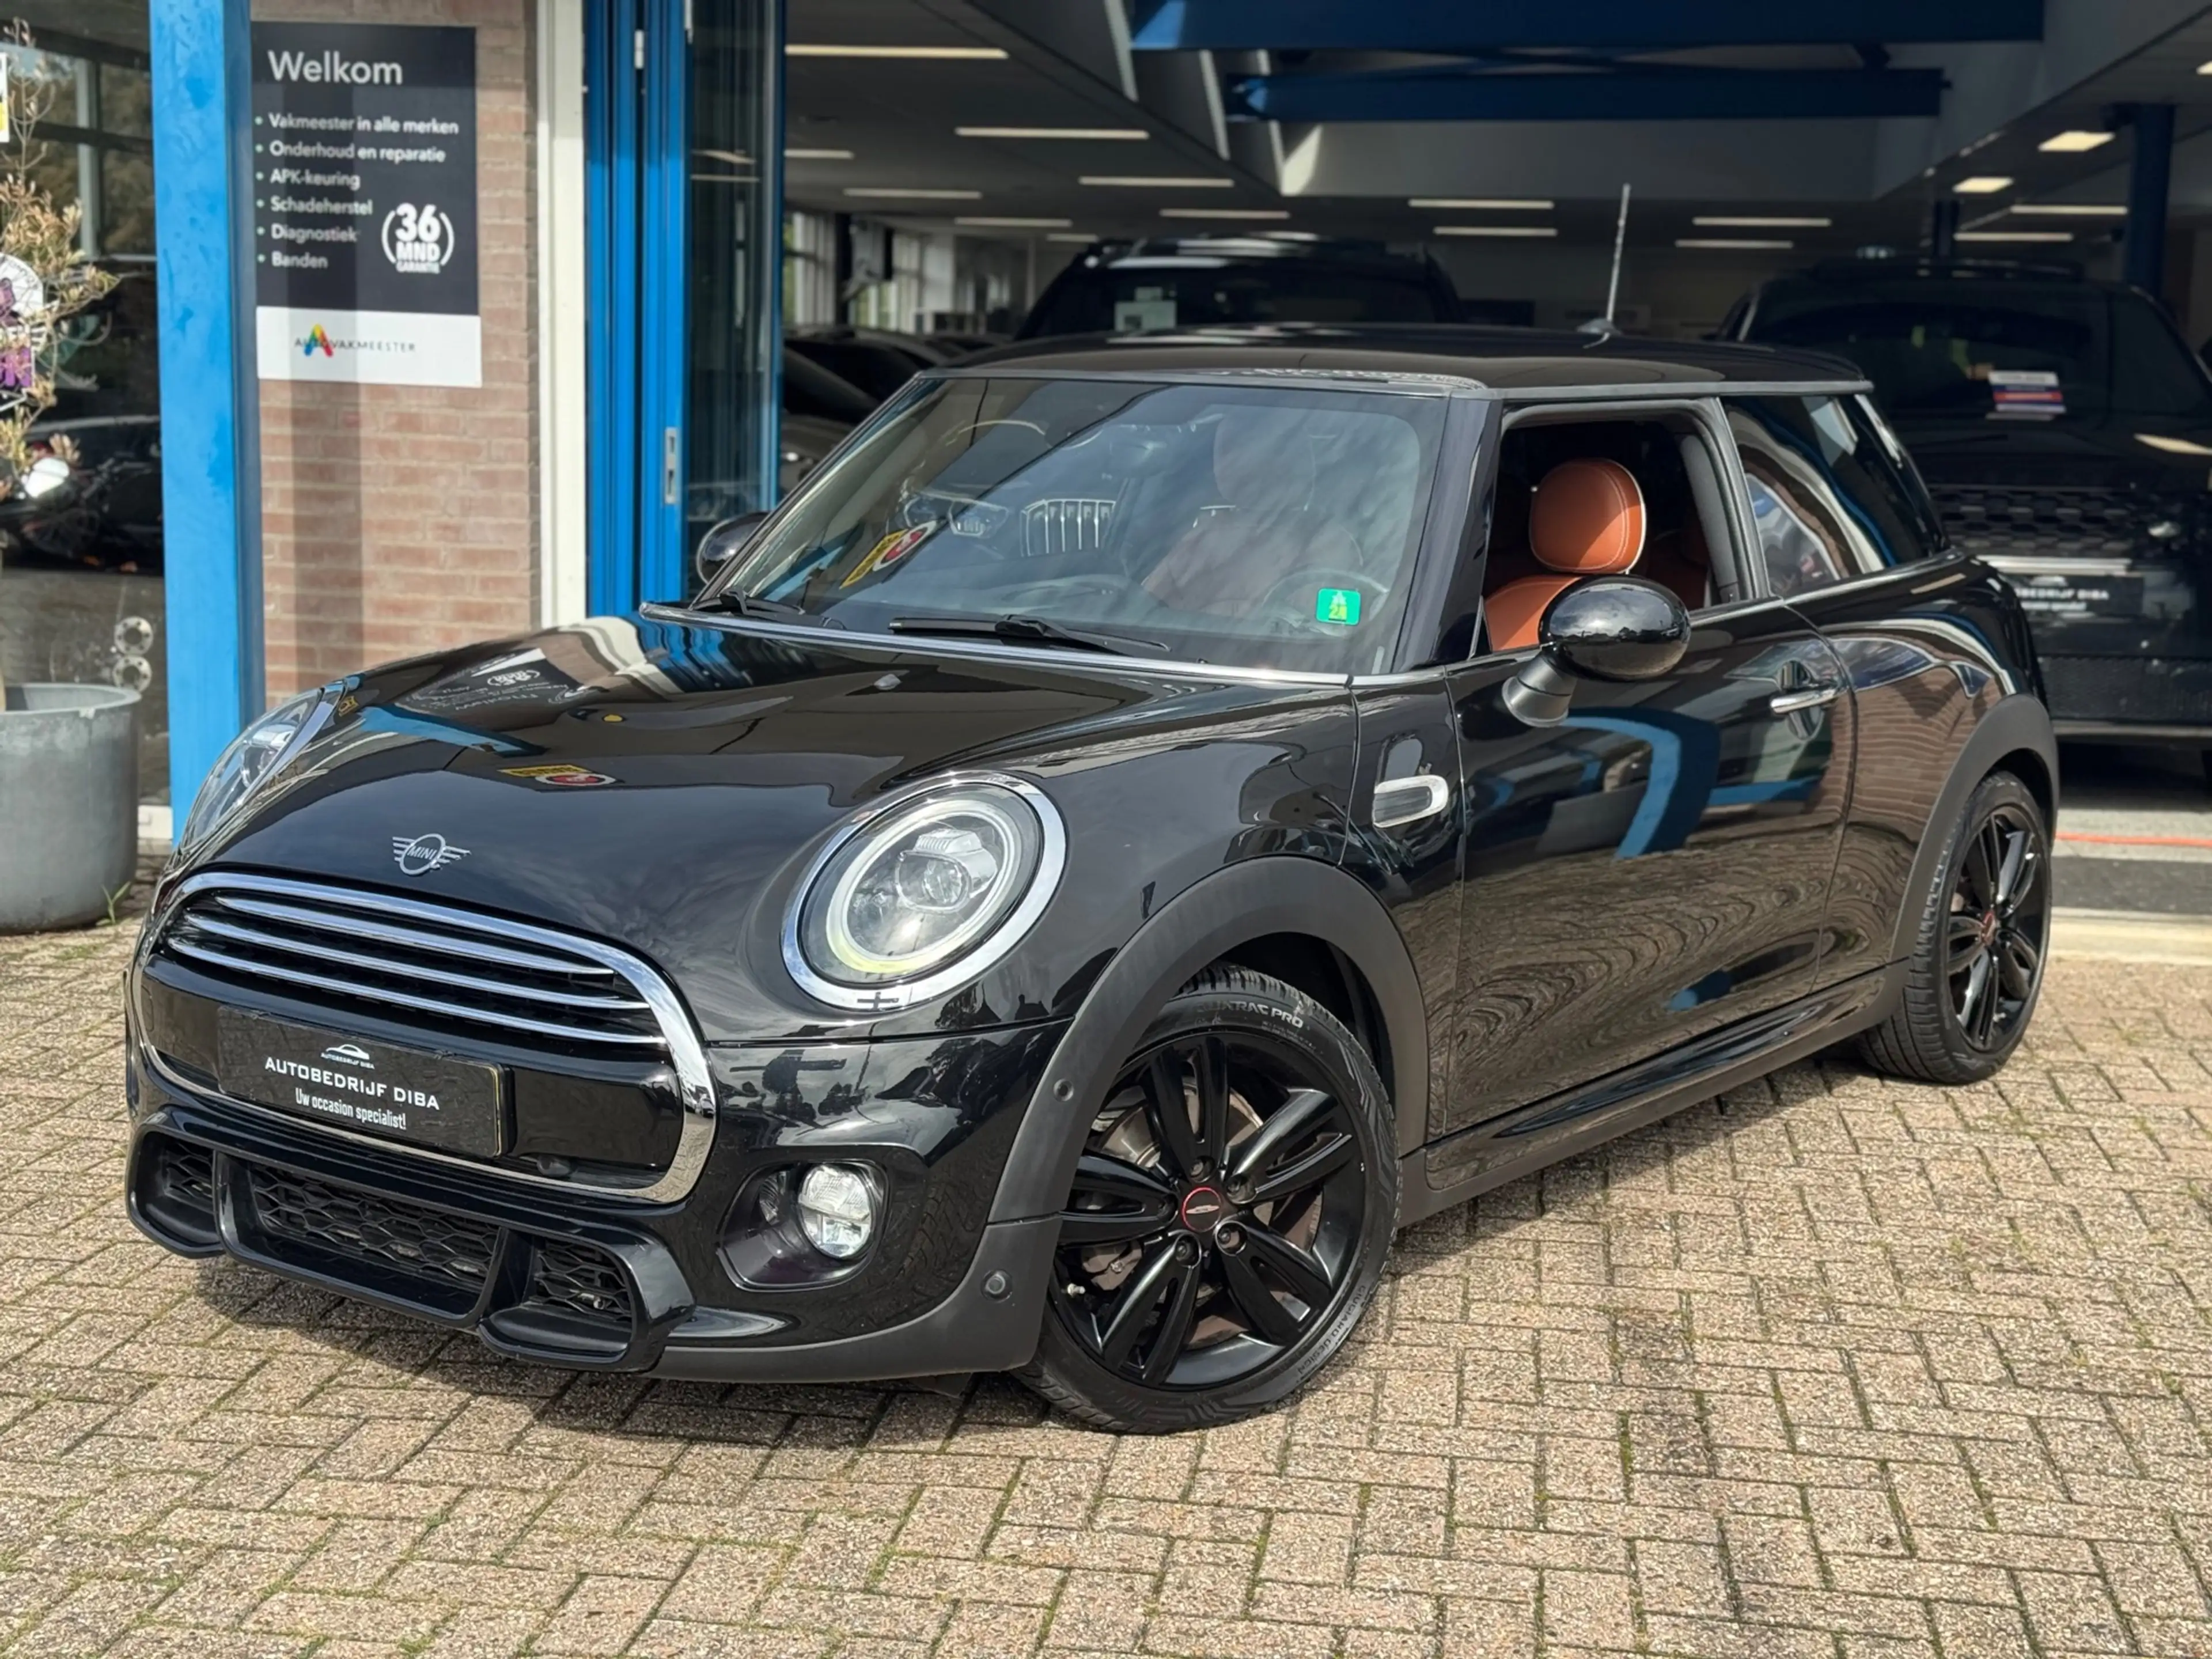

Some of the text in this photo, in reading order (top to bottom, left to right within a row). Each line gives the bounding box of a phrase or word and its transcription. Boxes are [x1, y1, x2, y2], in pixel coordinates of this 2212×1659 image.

[268, 50, 403, 85] Welkom
[268, 113, 459, 134] Vakmeester in alle merken
[270, 140, 445, 164] Onderhoud en reparatie
[270, 168, 361, 191] APK-keuring
[271, 196, 373, 215] Schadeherstel
[271, 224, 357, 244] Diagnostiek
[271, 251, 328, 269] Banden
[396, 241, 441, 262] MND
[407, 845, 437, 860] MINI
[1271, 1007, 1304, 1028] PRO
[265, 1057, 440, 1110] AUTOBEDRIJF DIBA
[295, 1087, 407, 1130] Uw occasion specialist!
